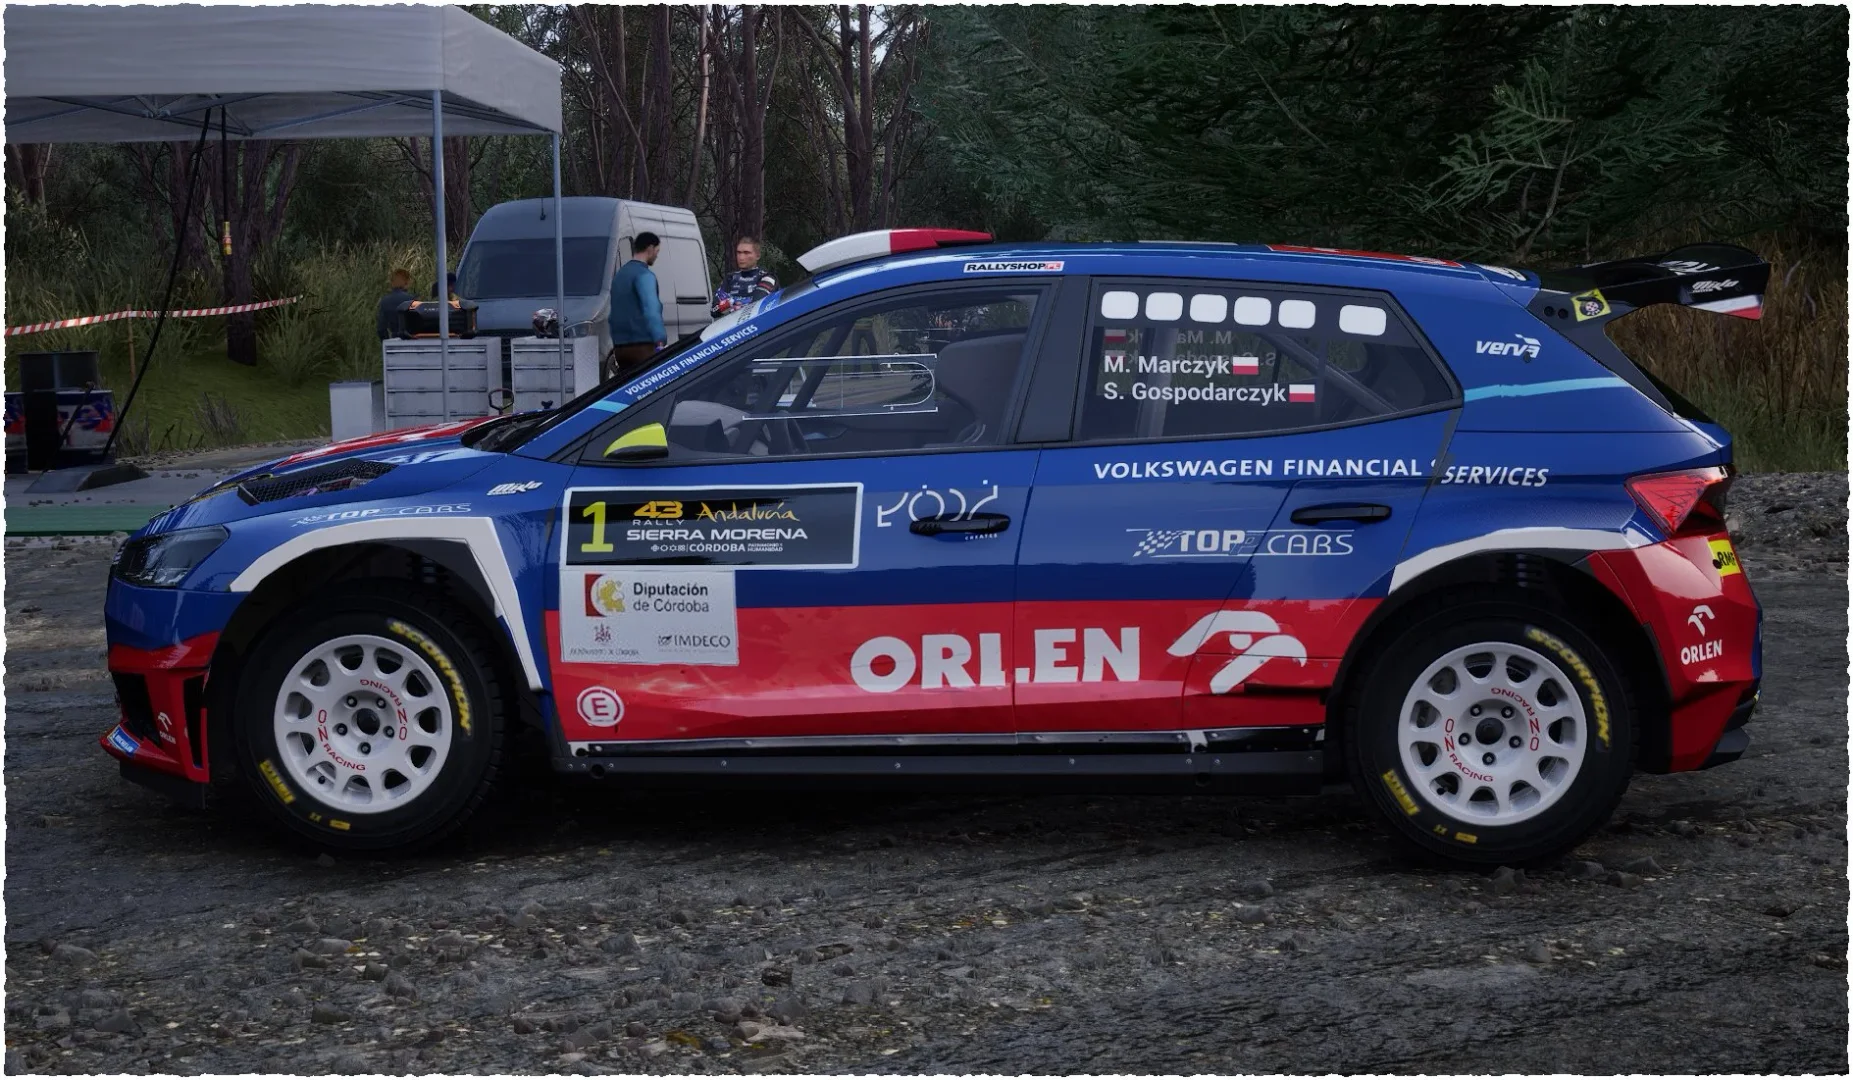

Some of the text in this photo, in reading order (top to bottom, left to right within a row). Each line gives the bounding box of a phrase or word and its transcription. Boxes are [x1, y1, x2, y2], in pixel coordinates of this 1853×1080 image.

[625, 364, 681, 396] VOLKSWAGEN
[680, 344, 723, 368] FINANCIAL
[723, 324, 758, 347] SERVICES
[1104, 356, 1131, 373] M.
[1138, 355, 1230, 378] Marczyk
[1104, 382, 1287, 406] S. Gospodarczyk
[1094, 460, 1549, 487] VOLKSWAGEN FINANCIAL SERVICES
[633, 501, 800, 522] 43 Andalucía
[581, 501, 614, 552] 1
[626, 528, 808, 541] SIERRA MORENA
[689, 541, 745, 552] CÓRDOBA
[633, 582, 708, 597] Diputación
[633, 599, 710, 613] de Córdoba
[674, 635, 731, 649] IMDECO
[1680, 639, 1723, 665] ORLEN
[851, 627, 1141, 694] ORLEN
